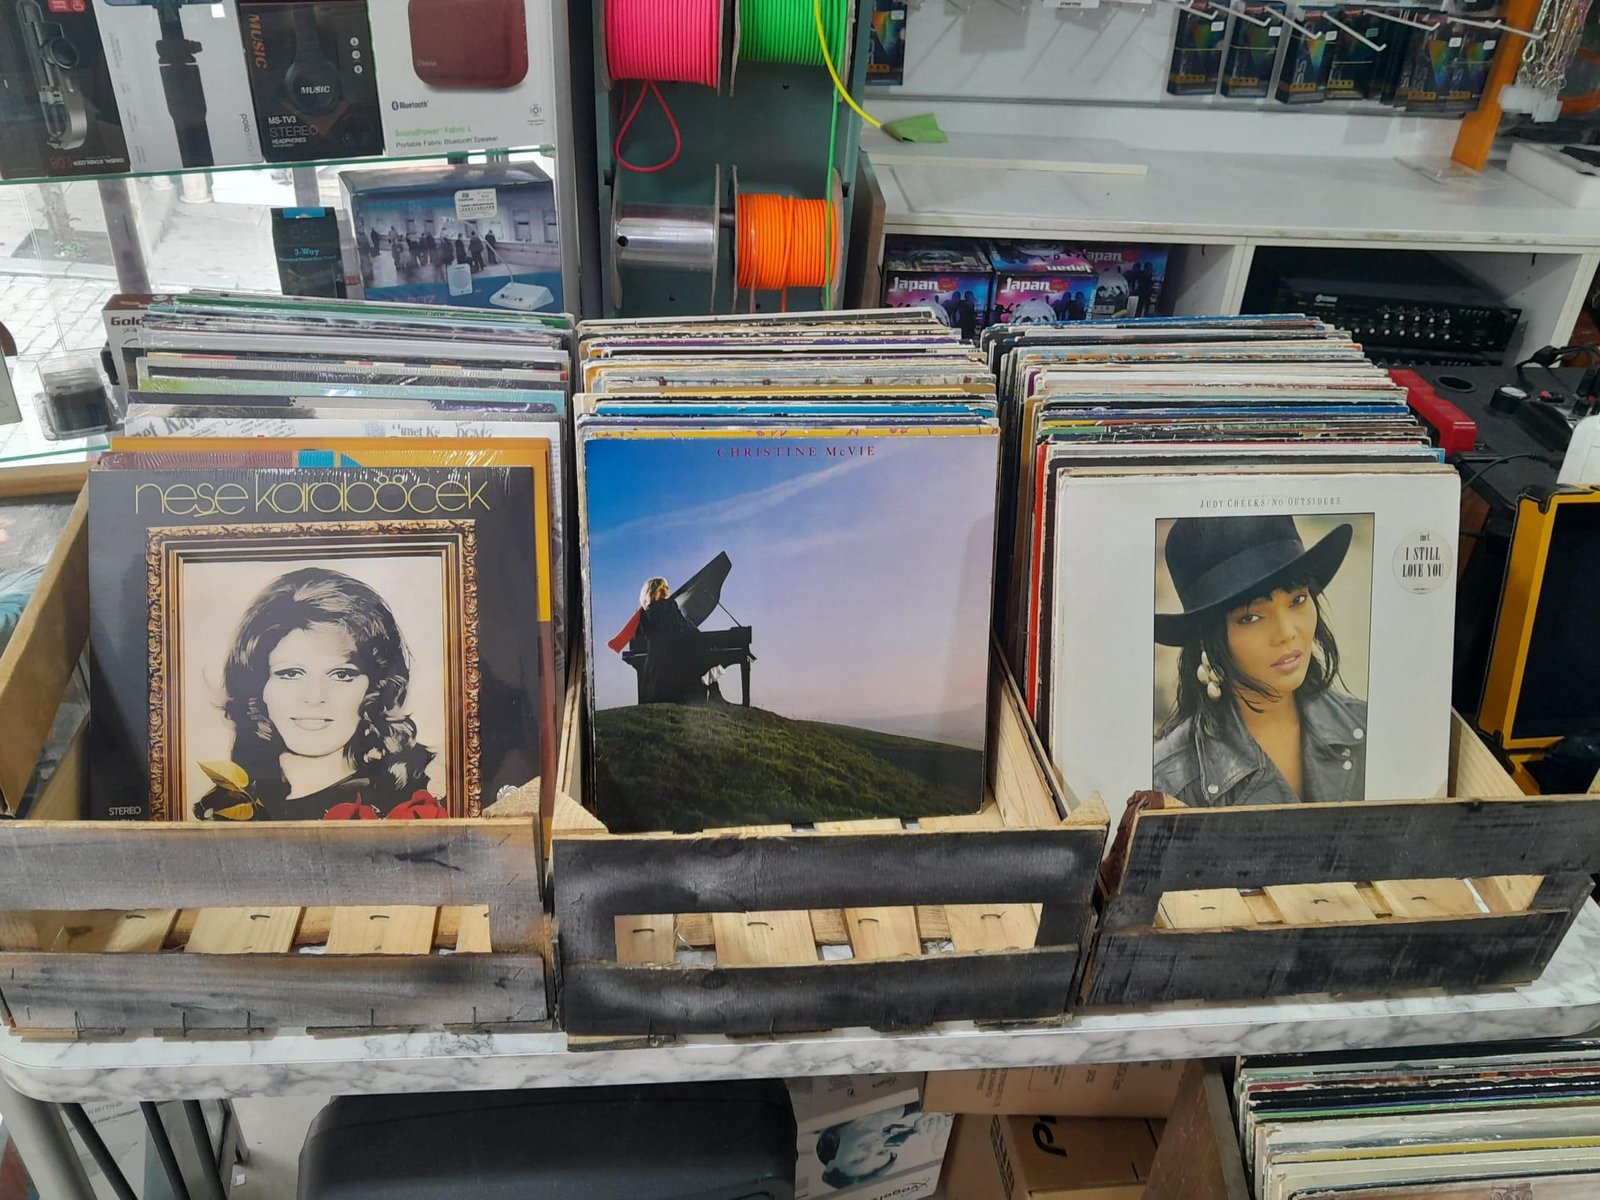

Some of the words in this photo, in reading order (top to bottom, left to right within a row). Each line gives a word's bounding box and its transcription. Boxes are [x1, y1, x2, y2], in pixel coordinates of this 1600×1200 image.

[248, 13, 267, 69] MUSIC
[300, 85, 331, 95] MUSIC
[399, 100, 428, 109] Bluetooth
[268, 116, 297, 125] MS-TV3
[269, 125, 319, 138] STEREO
[271, 137, 307, 145] HEADPHONES
[396, 140, 422, 149] Portable
[423, 138, 442, 147] Fabric
[473, 135, 498, 144] Speaker
[892, 277, 939, 292] Japan
[1002, 277, 1051, 292] Japan
[717, 446, 817, 457] CHRISTINE
[825, 445, 876, 457] McVIE
[256, 472, 490, 514] karaböcek
[1200, 498, 1224, 508] JUDY
[1287, 496, 1341, 506] OUTSIDERS
[1405, 547, 1409, 560] I
[1413, 547, 1440, 560] STILL
[1402, 563, 1423, 577] LOVE
[1427, 563, 1444, 577] YOU
[108, 806, 142, 816] STEREO
